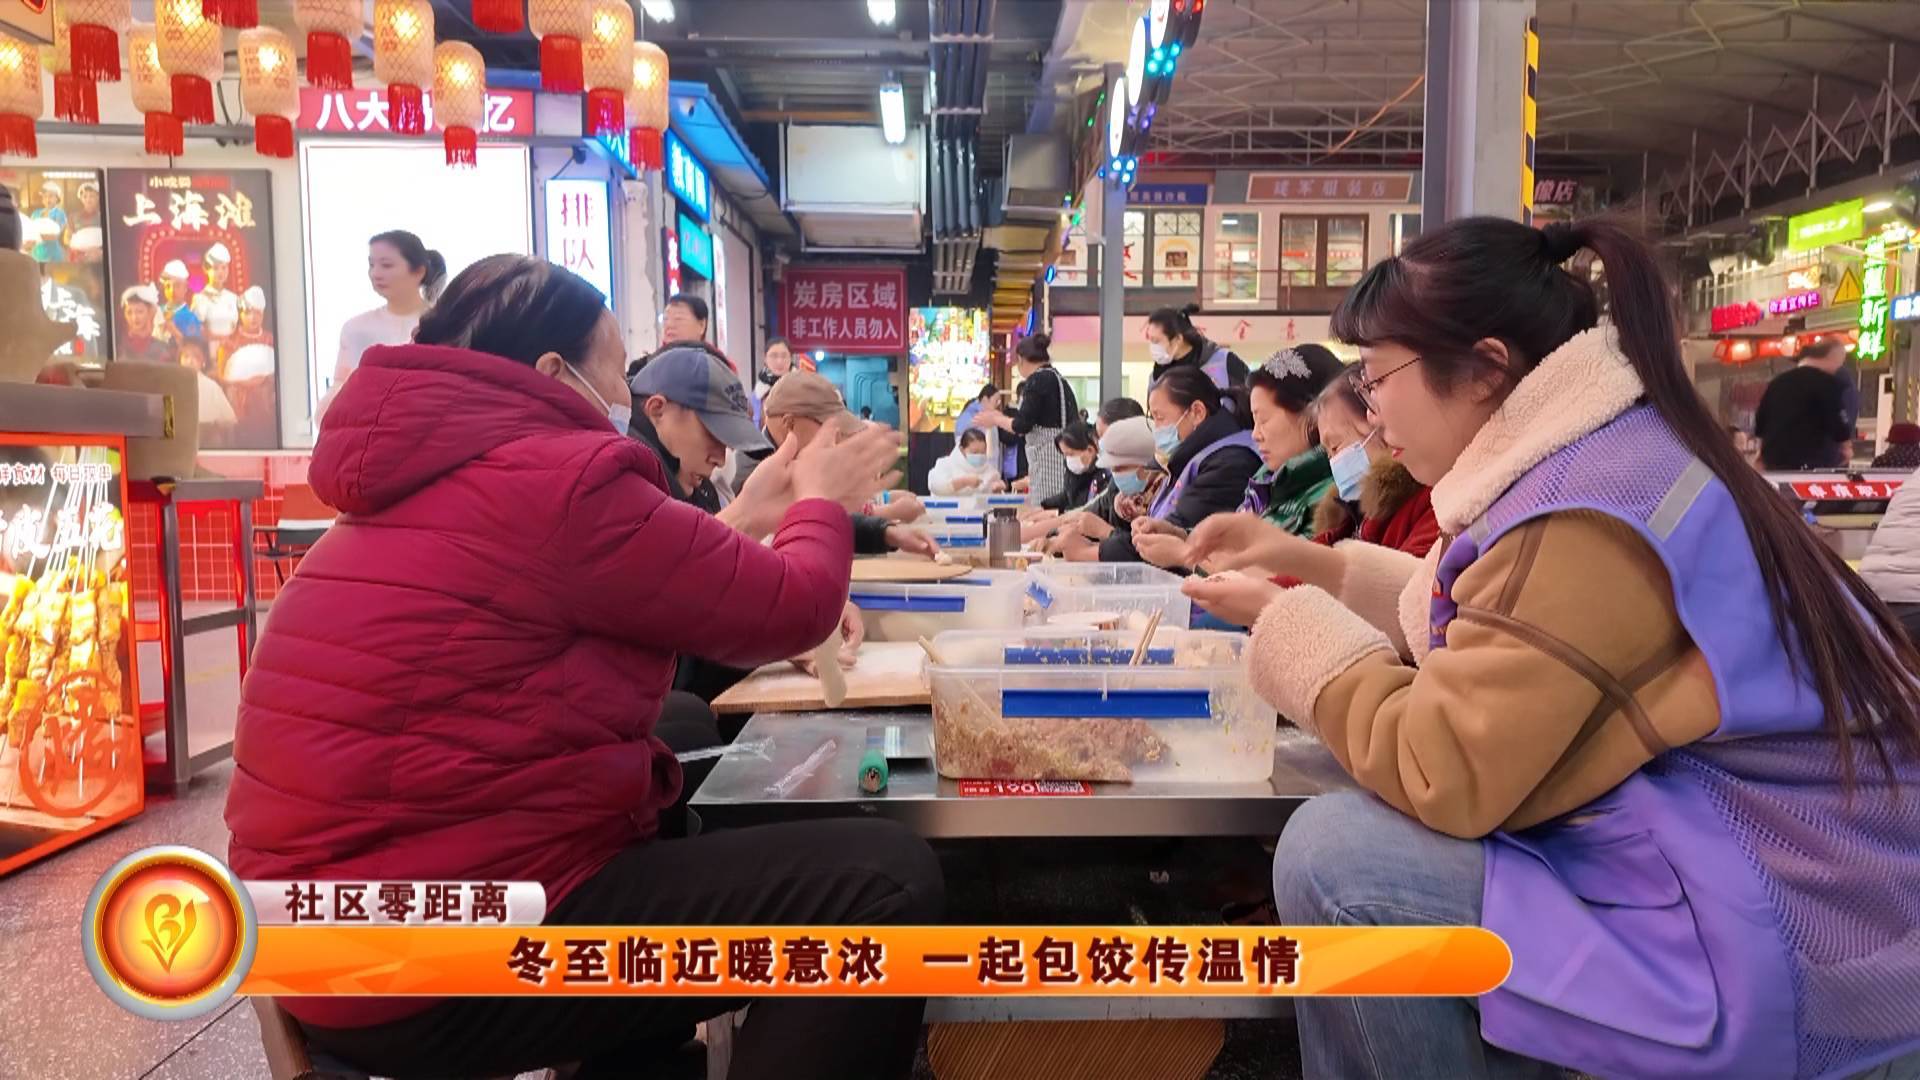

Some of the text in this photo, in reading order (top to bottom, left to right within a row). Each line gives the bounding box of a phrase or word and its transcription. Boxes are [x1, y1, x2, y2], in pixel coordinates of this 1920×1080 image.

[316, 92, 515, 132] 八大忆
[122, 189, 256, 232] 上海滩
[560, 192, 595, 270] 排队
[792, 280, 898, 310] 炭房区域
[792, 316, 898, 339] 非工作人员勿入
